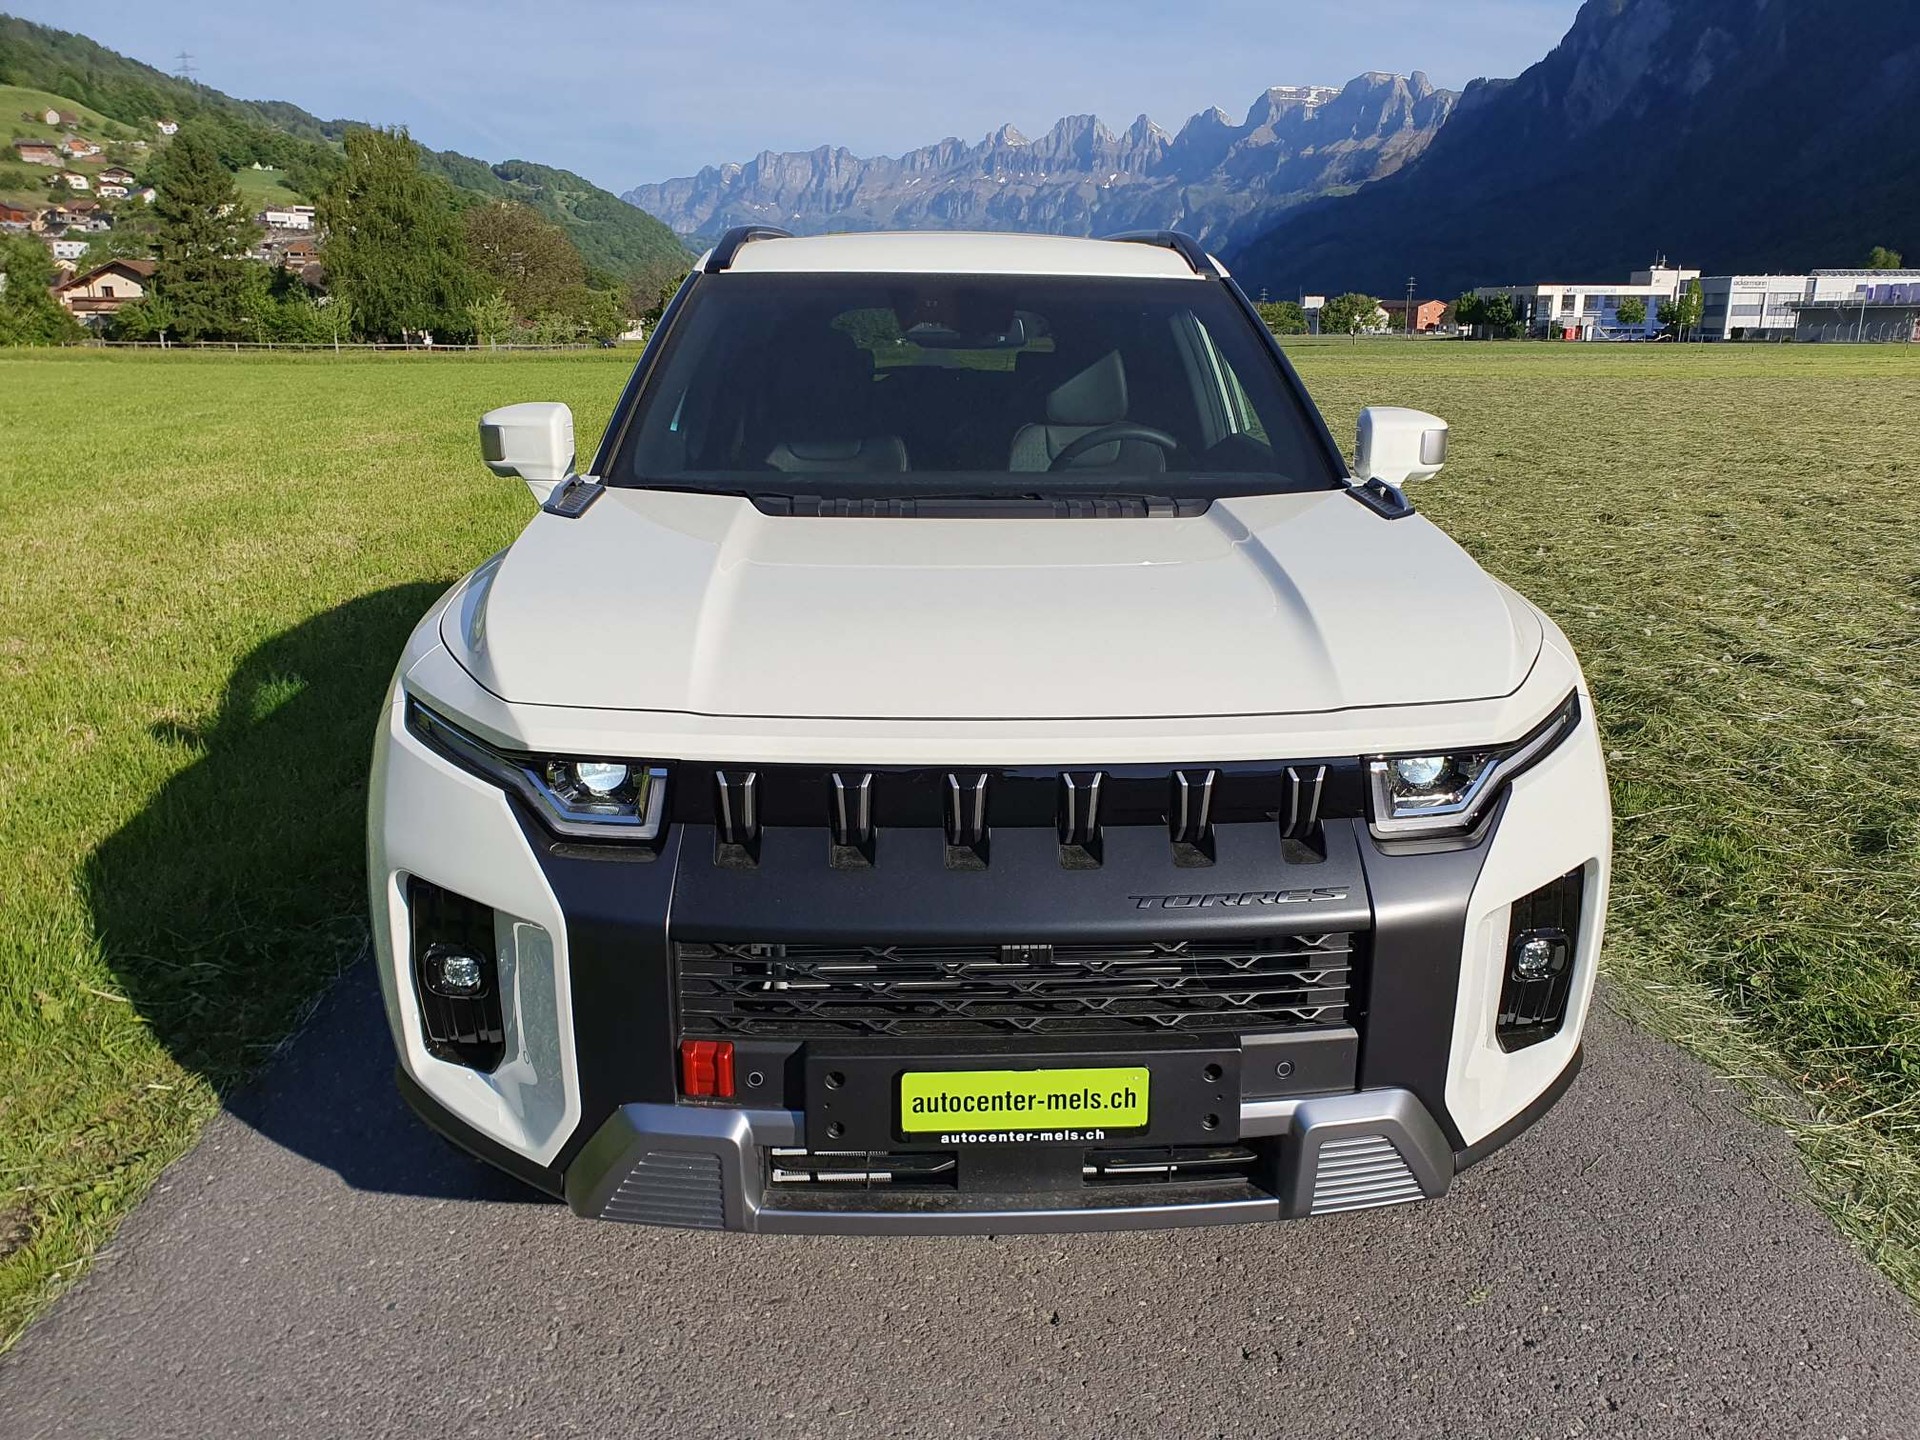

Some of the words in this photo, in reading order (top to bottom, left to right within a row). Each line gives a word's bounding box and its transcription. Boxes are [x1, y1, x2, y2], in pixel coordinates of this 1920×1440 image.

[1128, 886, 1350, 909] TORRES
[912, 1087, 1136, 1113] autocenter-mels.ch
[941, 1129, 1105, 1144] autocenter-mels.ch
